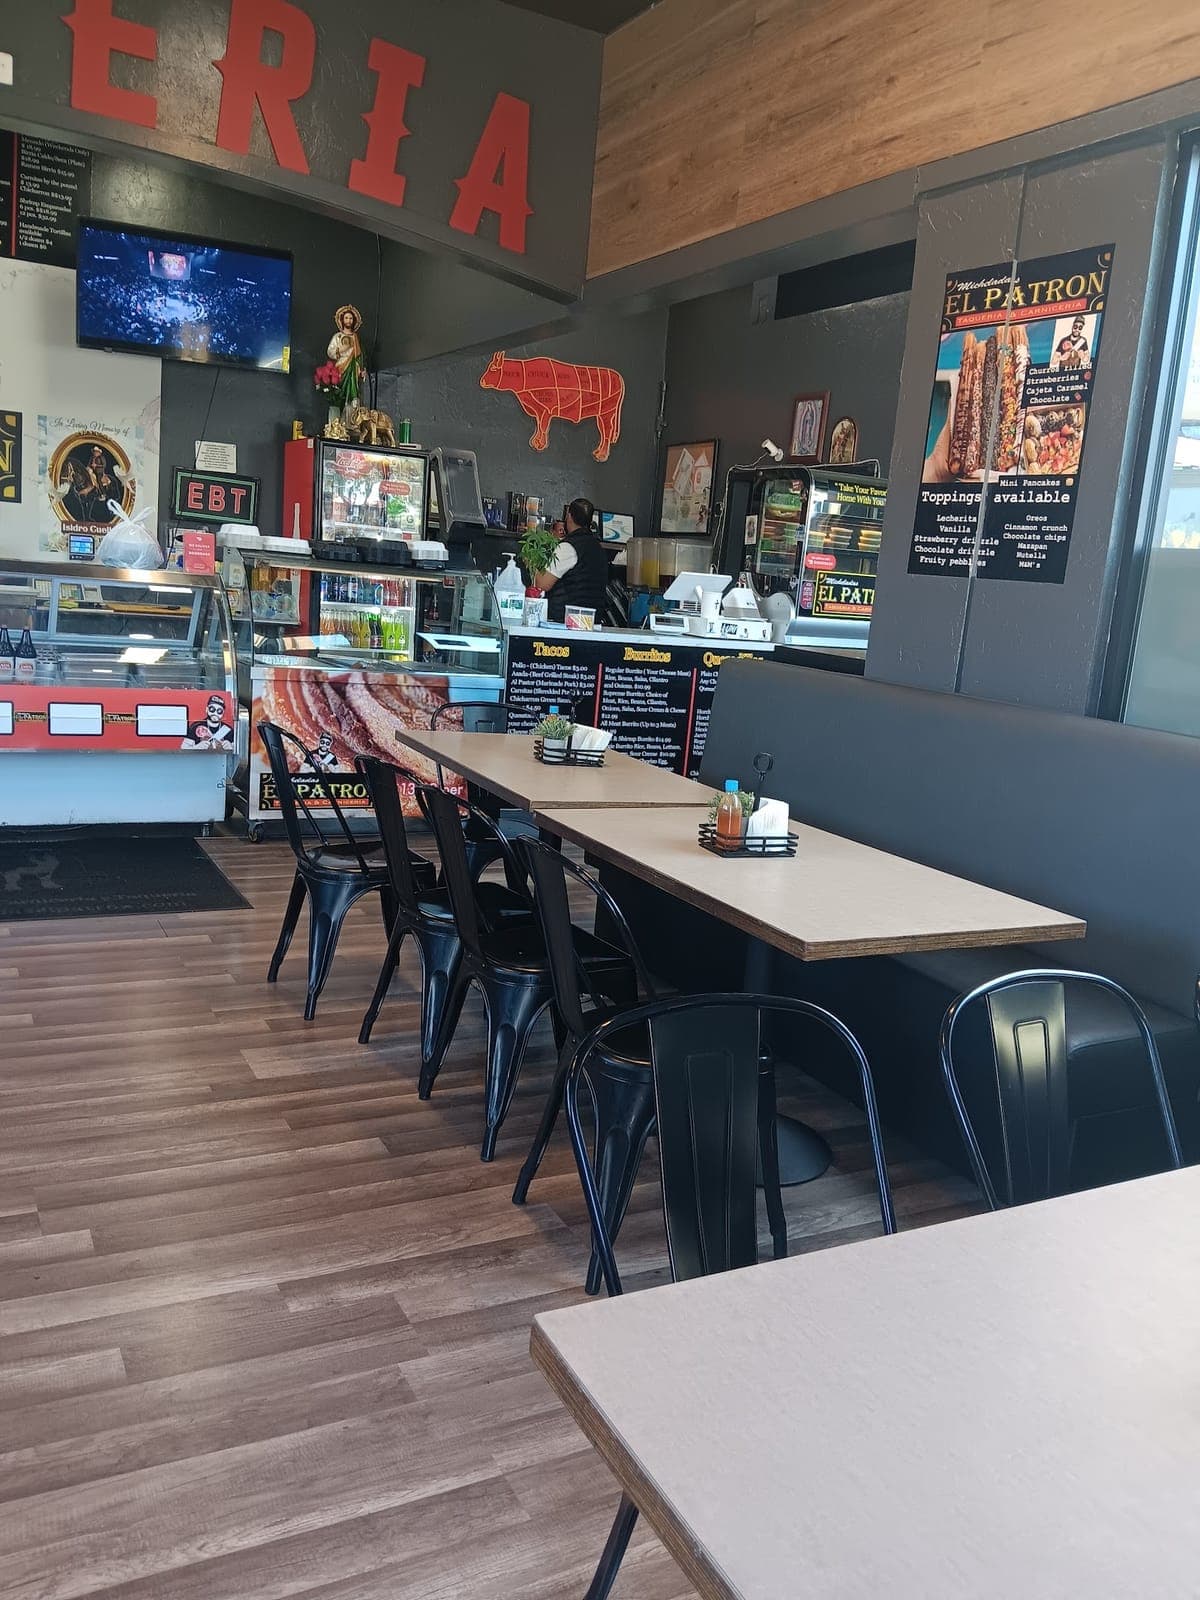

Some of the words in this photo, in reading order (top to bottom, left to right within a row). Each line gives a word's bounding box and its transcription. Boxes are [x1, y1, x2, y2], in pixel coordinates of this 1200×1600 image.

[945, 292, 976, 315] EL
[984, 270, 1107, 310] PATRON
[956, 312, 1003, 324] TAQUERIA
[1020, 302, 1082, 316] CARNICERIA
[1029, 366, 1060, 375] Churros
[1026, 374, 1080, 385] Strawberries
[1026, 387, 1052, 396] Cajeta
[1056, 382, 1088, 392] Caramel
[1030, 395, 1070, 404] Chocolate
[838, 483, 854, 493] Take
[855, 485, 869, 494] Your
[188, 482, 246, 514] EBT
[837, 492, 856, 503] Home
[857, 495, 871, 504] With
[922, 491, 982, 505] Toppings
[993, 491, 1071, 503] available
[63, 524, 88, 532] Isidro
[914, 535, 958, 544] Strawberry
[1044, 534, 1066, 542] chips
[914, 546, 954, 554] Chocolate
[1018, 542, 1047, 551] Mazapan
[920, 556, 946, 565] Fruity
[950, 558, 986, 567] pebbles
[818, 586, 837, 602] EL
[840, 587, 875, 604] PAT
[533, 642, 570, 657] Tacos
[624, 647, 671, 663] Burritos
[297, 784, 369, 799] PATRO
